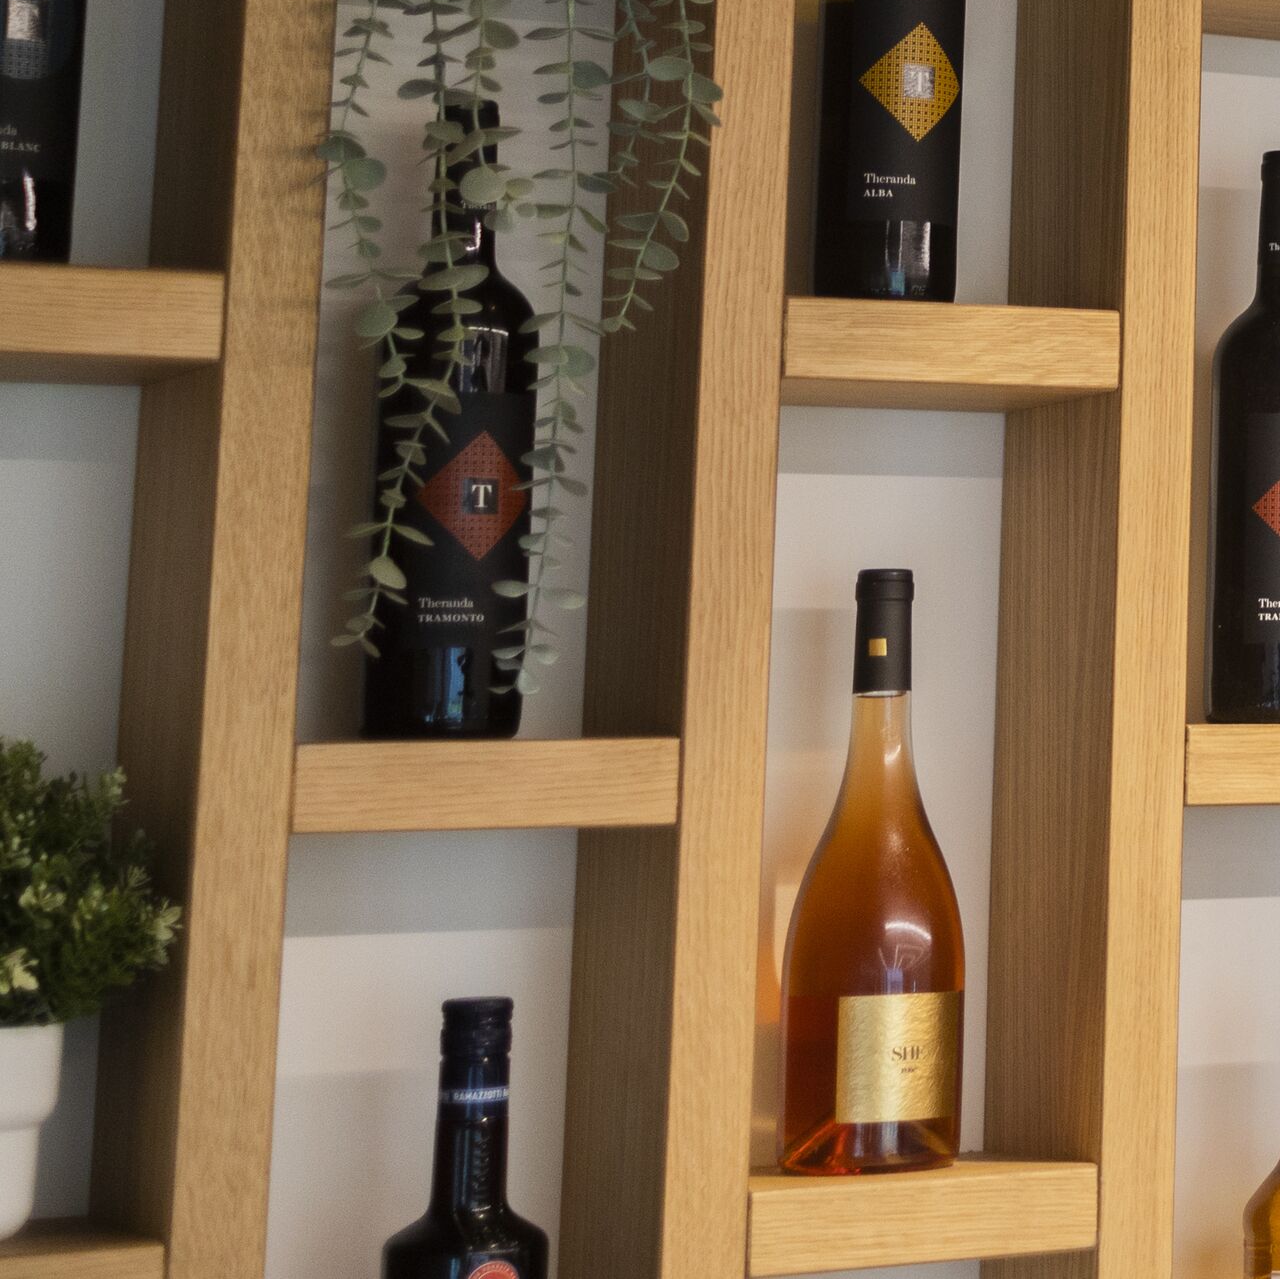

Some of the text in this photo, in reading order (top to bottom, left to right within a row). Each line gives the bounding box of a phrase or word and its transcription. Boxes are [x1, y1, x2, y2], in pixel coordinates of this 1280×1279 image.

[864, 172, 917, 185] Theranda
[864, 188, 894, 197] ALBA
[471, 484, 492, 508] T
[418, 597, 474, 609] Theranda
[418, 613, 485, 624] TRAMONTO
[892, 1046, 924, 1061] SHE
